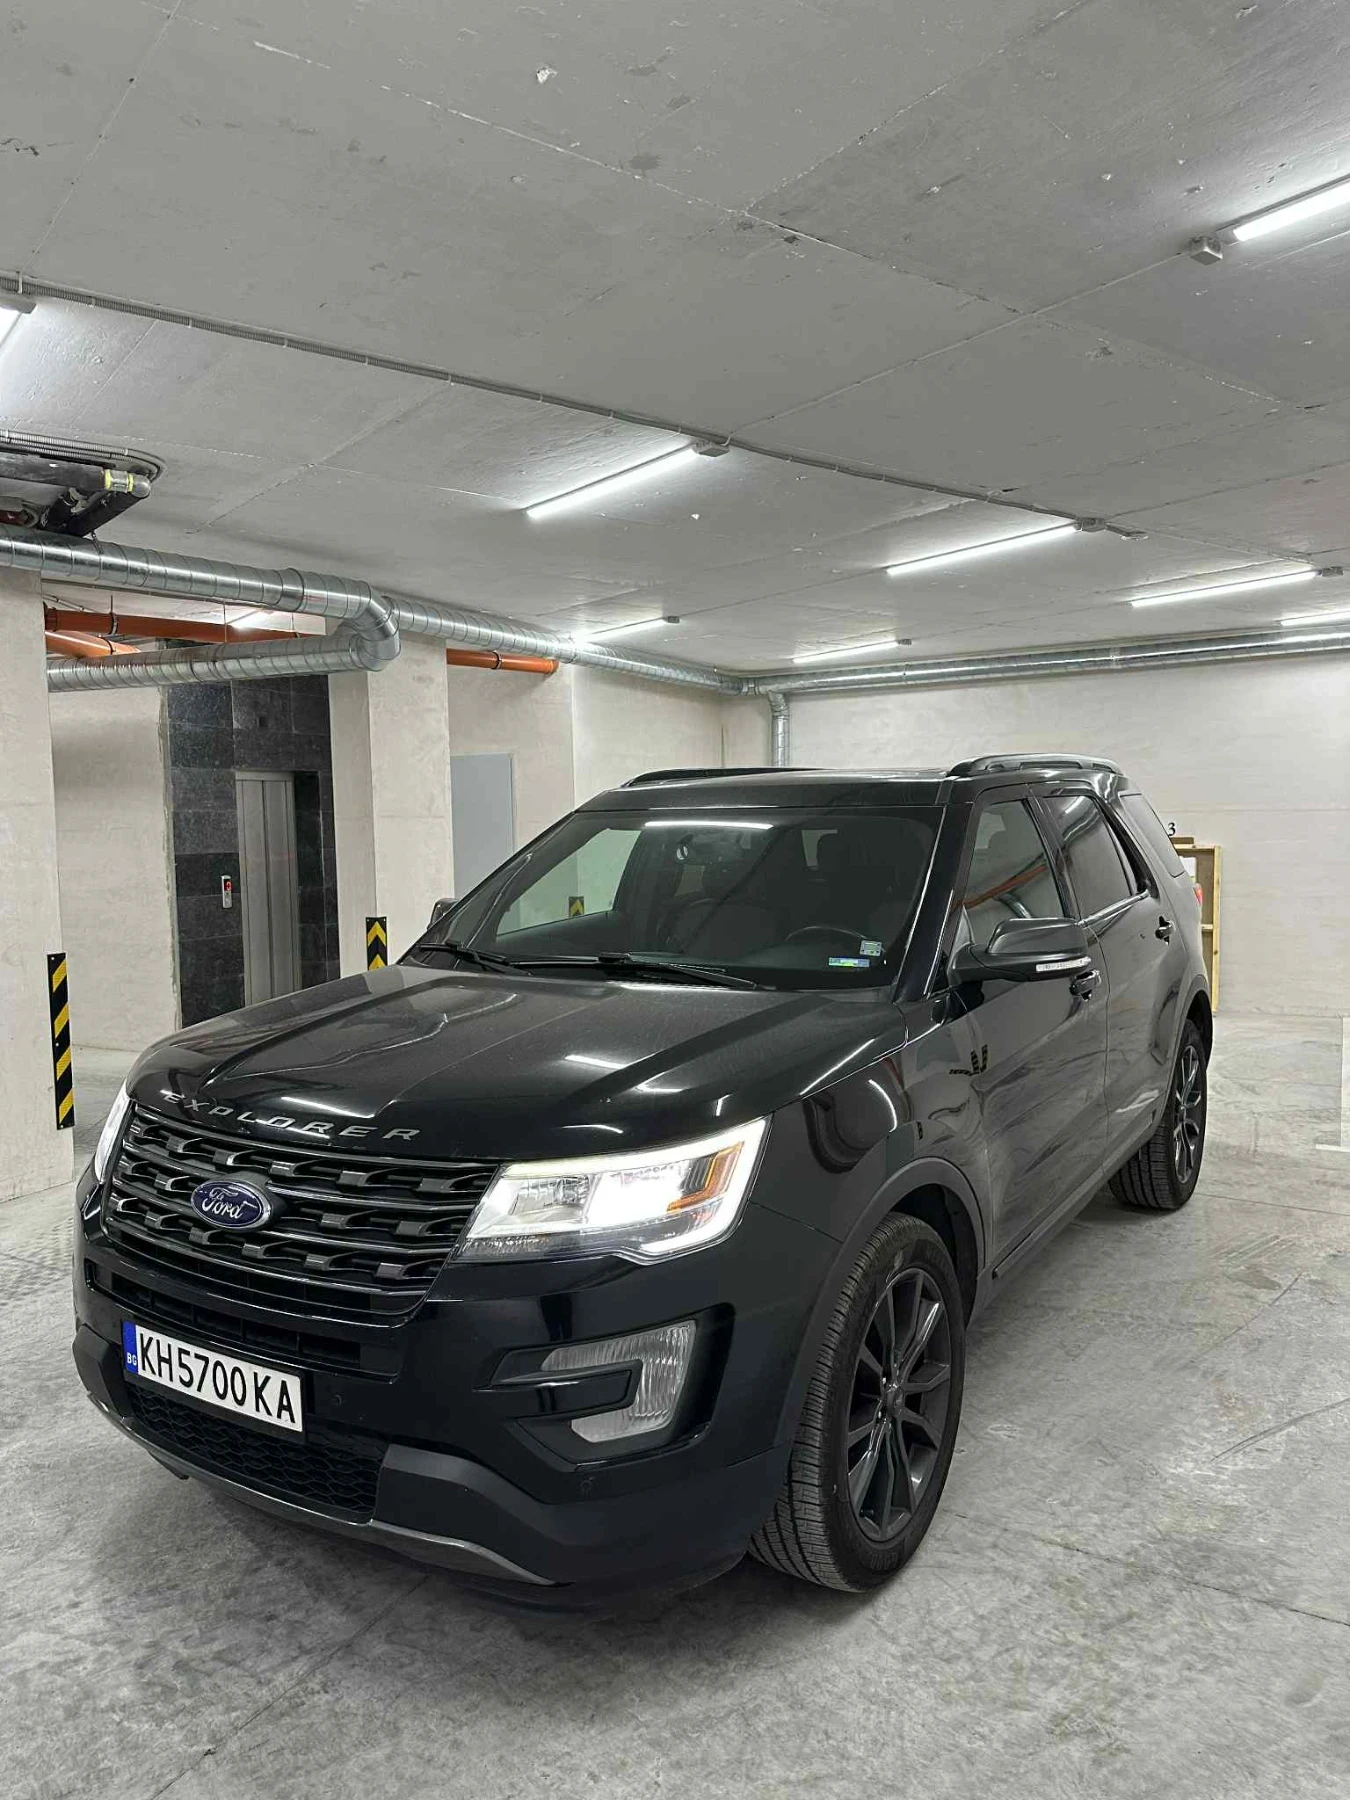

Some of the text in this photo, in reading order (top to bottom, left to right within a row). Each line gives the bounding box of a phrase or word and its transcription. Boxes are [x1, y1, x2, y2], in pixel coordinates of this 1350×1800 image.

[162, 1090, 421, 1141] EXPLORER
[202, 1187, 245, 1220] Ford
[126, 1352, 137, 1366] BG
[140, 1333, 296, 1424] KH5700KA
